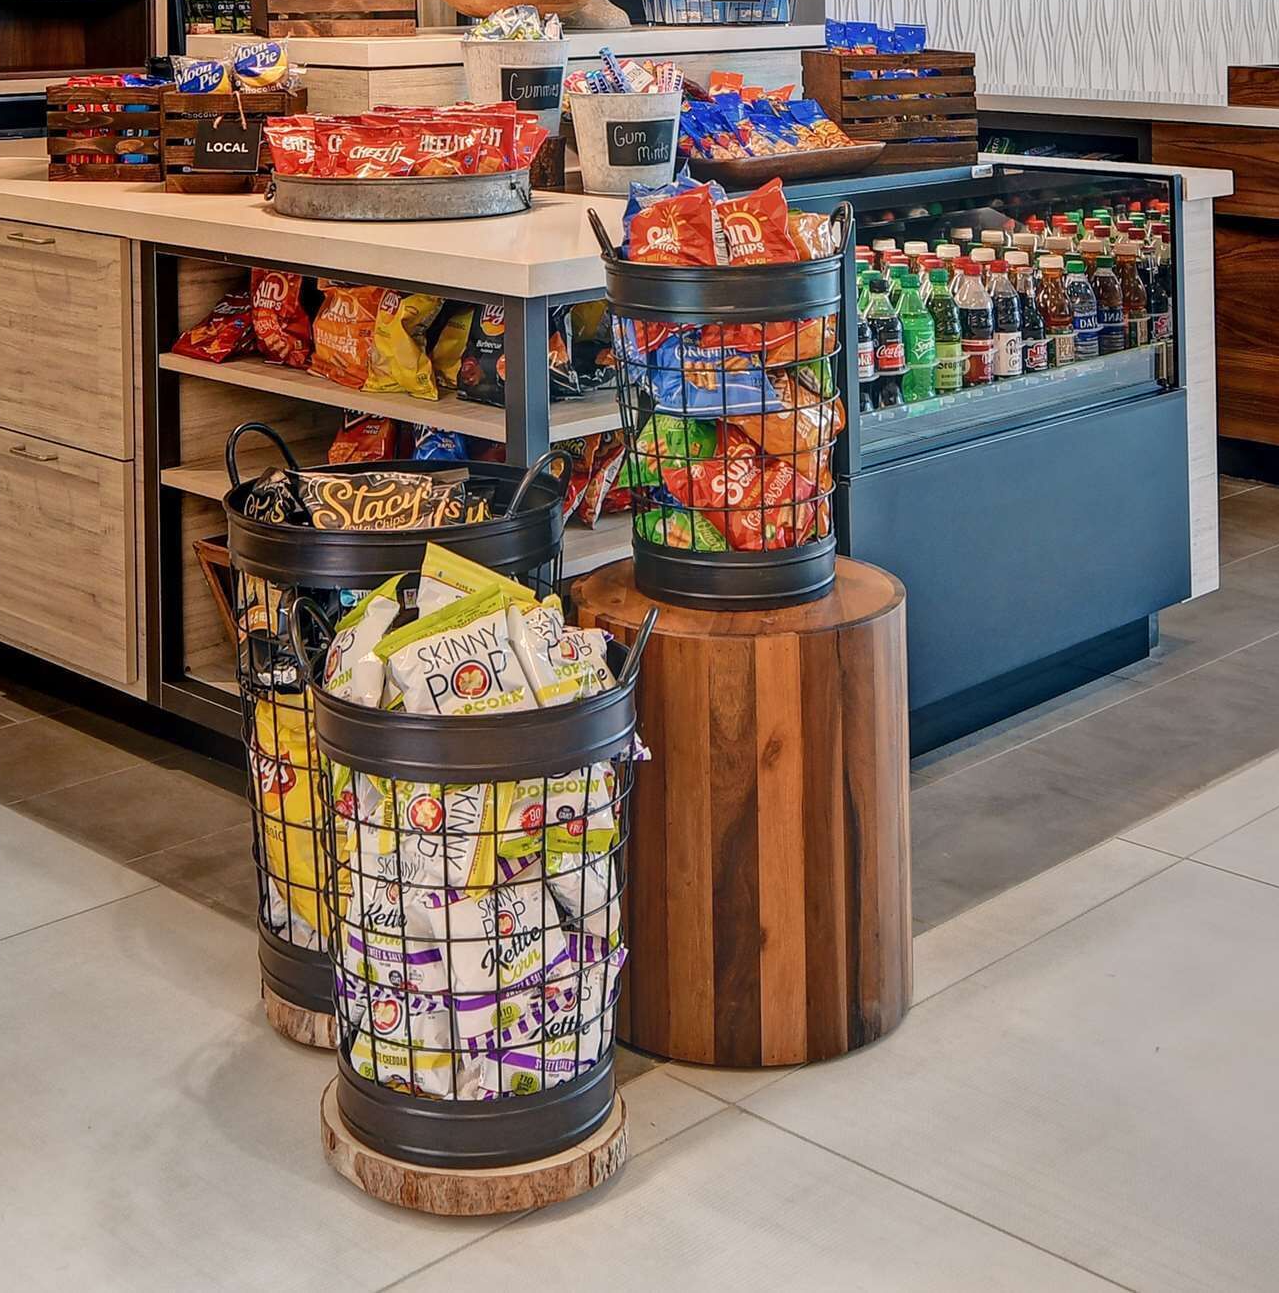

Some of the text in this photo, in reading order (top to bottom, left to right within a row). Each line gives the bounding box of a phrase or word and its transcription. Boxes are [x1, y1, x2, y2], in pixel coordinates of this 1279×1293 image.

[256, 48, 278, 67] Pie
[176, 62, 212, 84] Moon
[199, 71, 220, 89] Pie
[603, 57, 625, 93] mento
[613, 126, 646, 147] Gum
[206, 142, 249, 153] LOCAL
[482, 304, 505, 325] Lay
[312, 479, 432, 530] Stacy's
[375, 515, 406, 530] Chips
[426, 651, 507, 715] POP
[451, 687, 527, 715] PCORN
[517, 779, 600, 799] POCORN
[481, 926, 542, 978] Kettle
[383, 1055, 407, 1066] CHEDDAR
[535, 1059, 555, 1072] SEET
